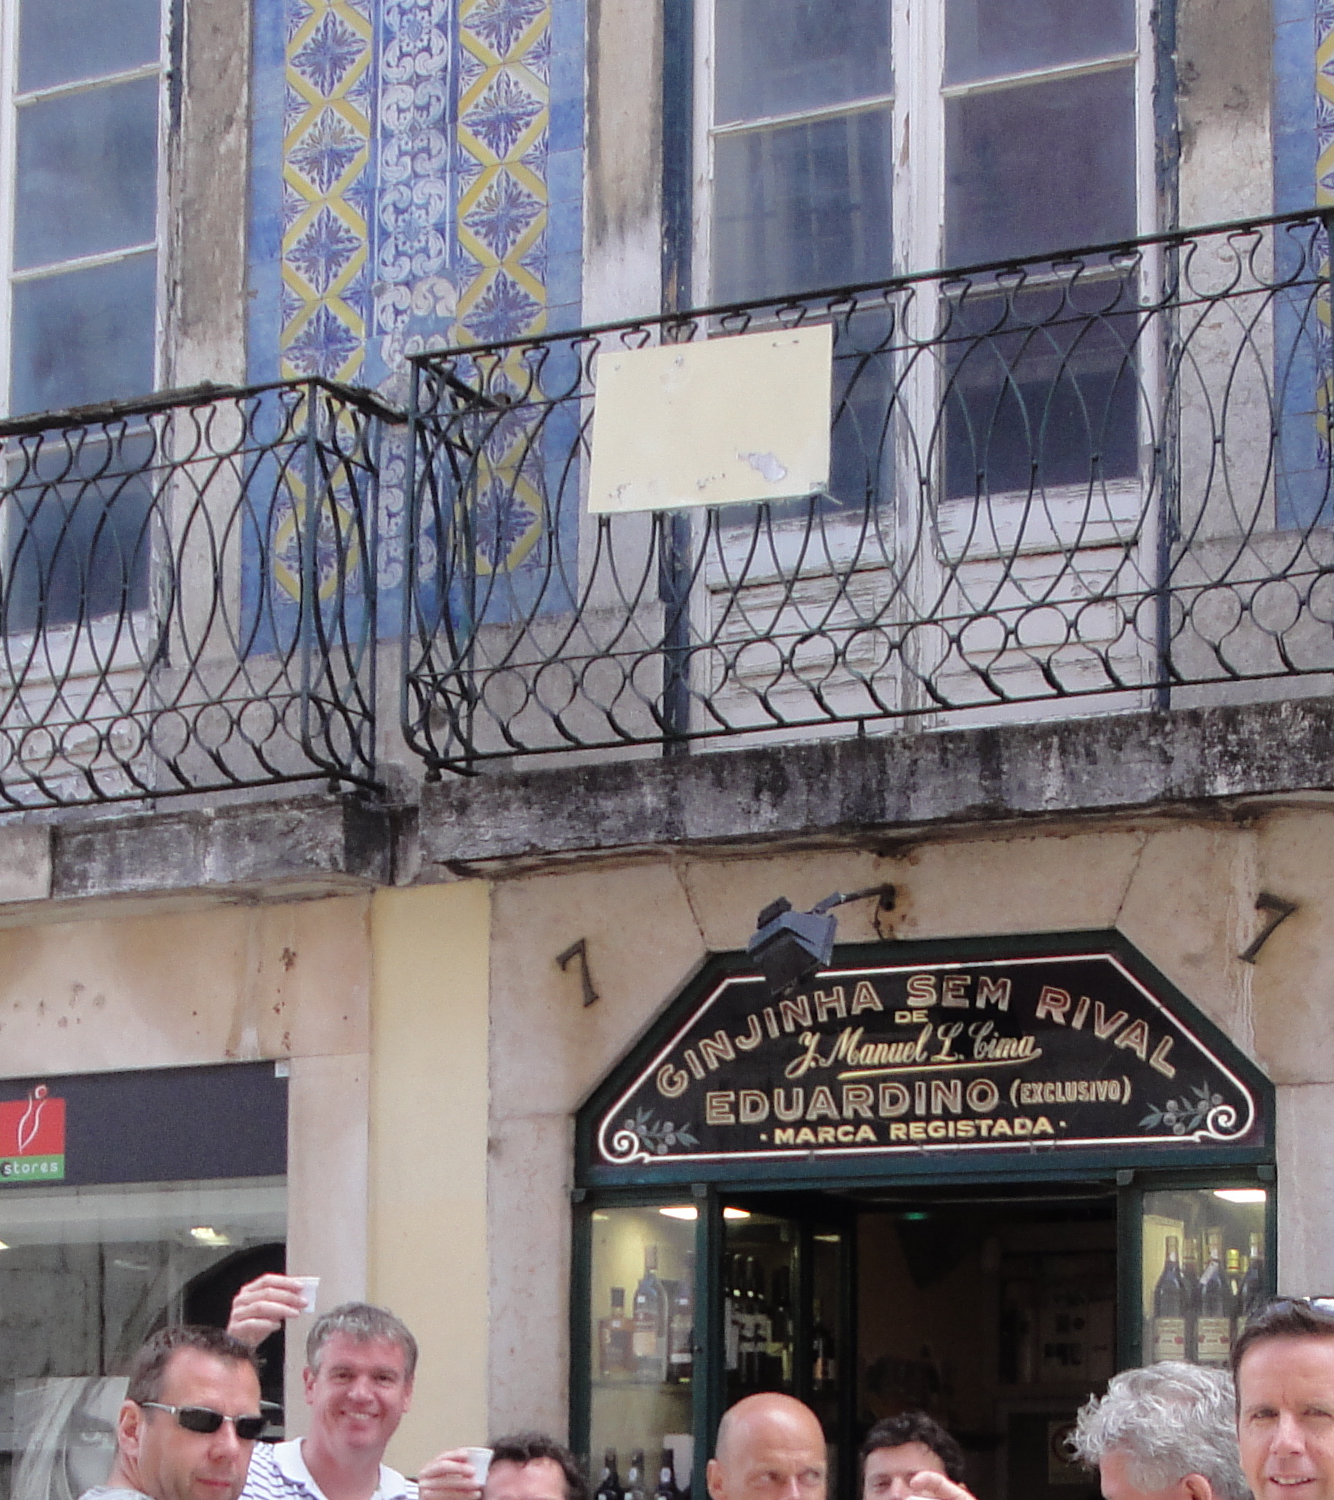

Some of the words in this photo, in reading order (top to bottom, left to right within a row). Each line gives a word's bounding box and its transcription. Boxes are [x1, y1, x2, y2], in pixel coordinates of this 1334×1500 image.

[894, 1009, 929, 1024] DE
[656, 980, 884, 1098] GINJINHA
[906, 974, 1011, 1012] SEM
[1035, 985, 1176, 1079] RIVAL
[819, 1022, 932, 1067] Manuel
[930, 1021, 965, 1062] L.
[968, 1020, 1042, 1059] Cima
[705, 1078, 999, 1125] EDUARDINO
[1010, 1075, 1131, 1108] (EXCLUSIVO)
[774, 1124, 877, 1145] MARCA
[889, 1117, 1054, 1141] REGISTADA
[2, 1161, 58, 1176] stores
